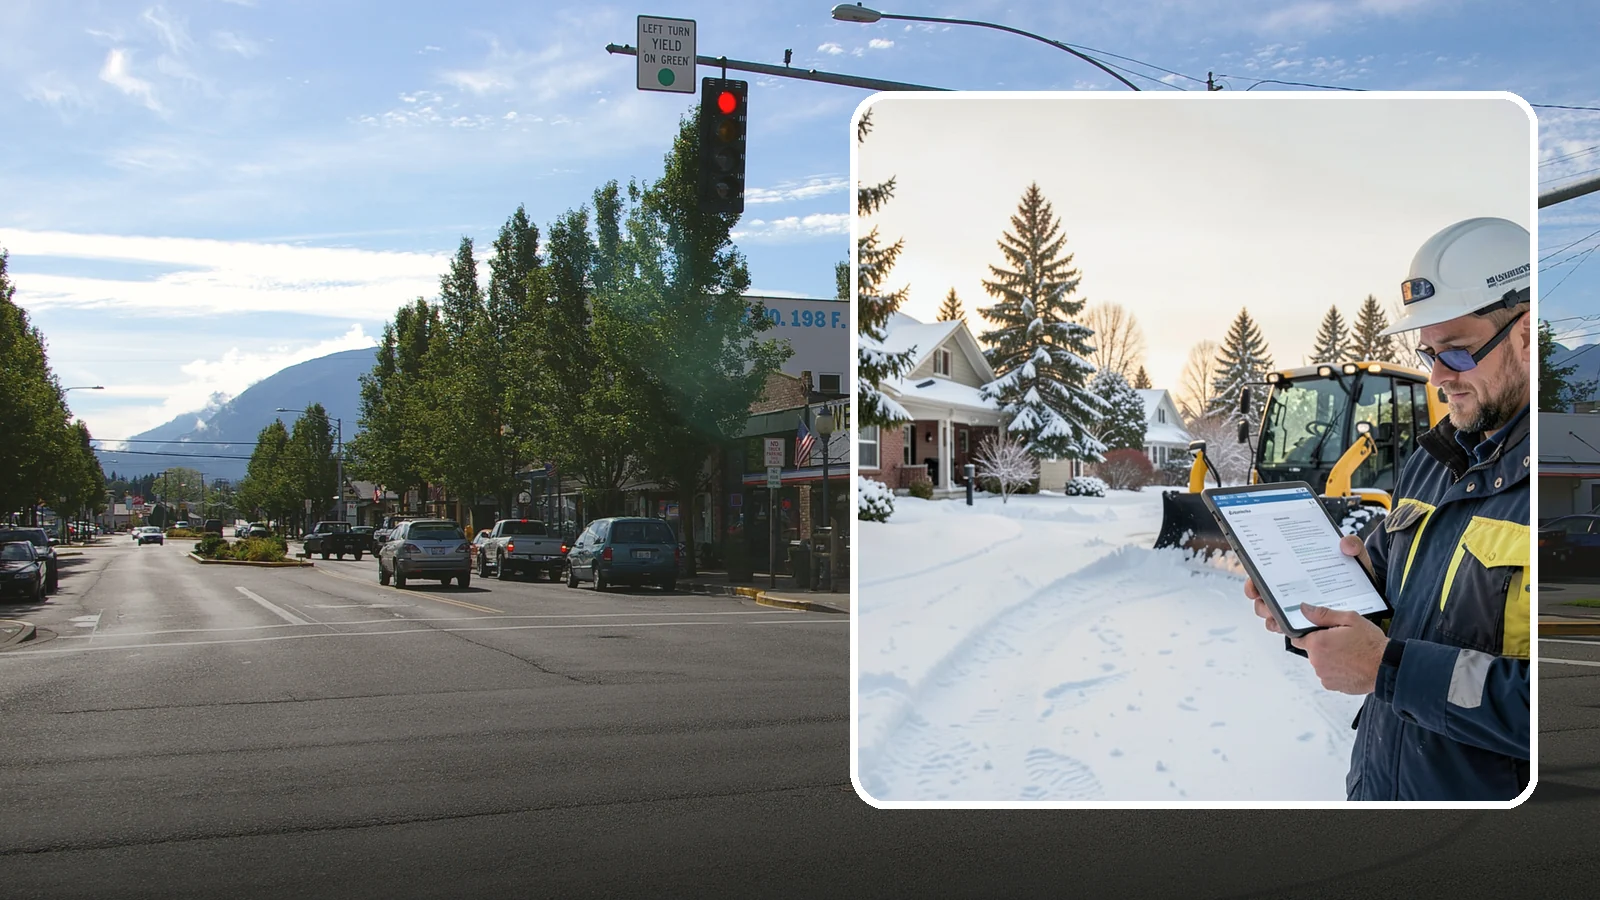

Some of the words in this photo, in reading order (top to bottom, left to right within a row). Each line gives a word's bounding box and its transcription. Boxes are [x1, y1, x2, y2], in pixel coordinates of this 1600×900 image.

[643, 23, 663, 34] LEFT
[668, 25, 690, 36] TURN
[652, 38, 682, 51] YIELD
[644, 53, 656, 63] ON
[661, 54, 689, 66] GREEN
[791, 309, 826, 328] 198
[831, 311, 846, 329] F.
